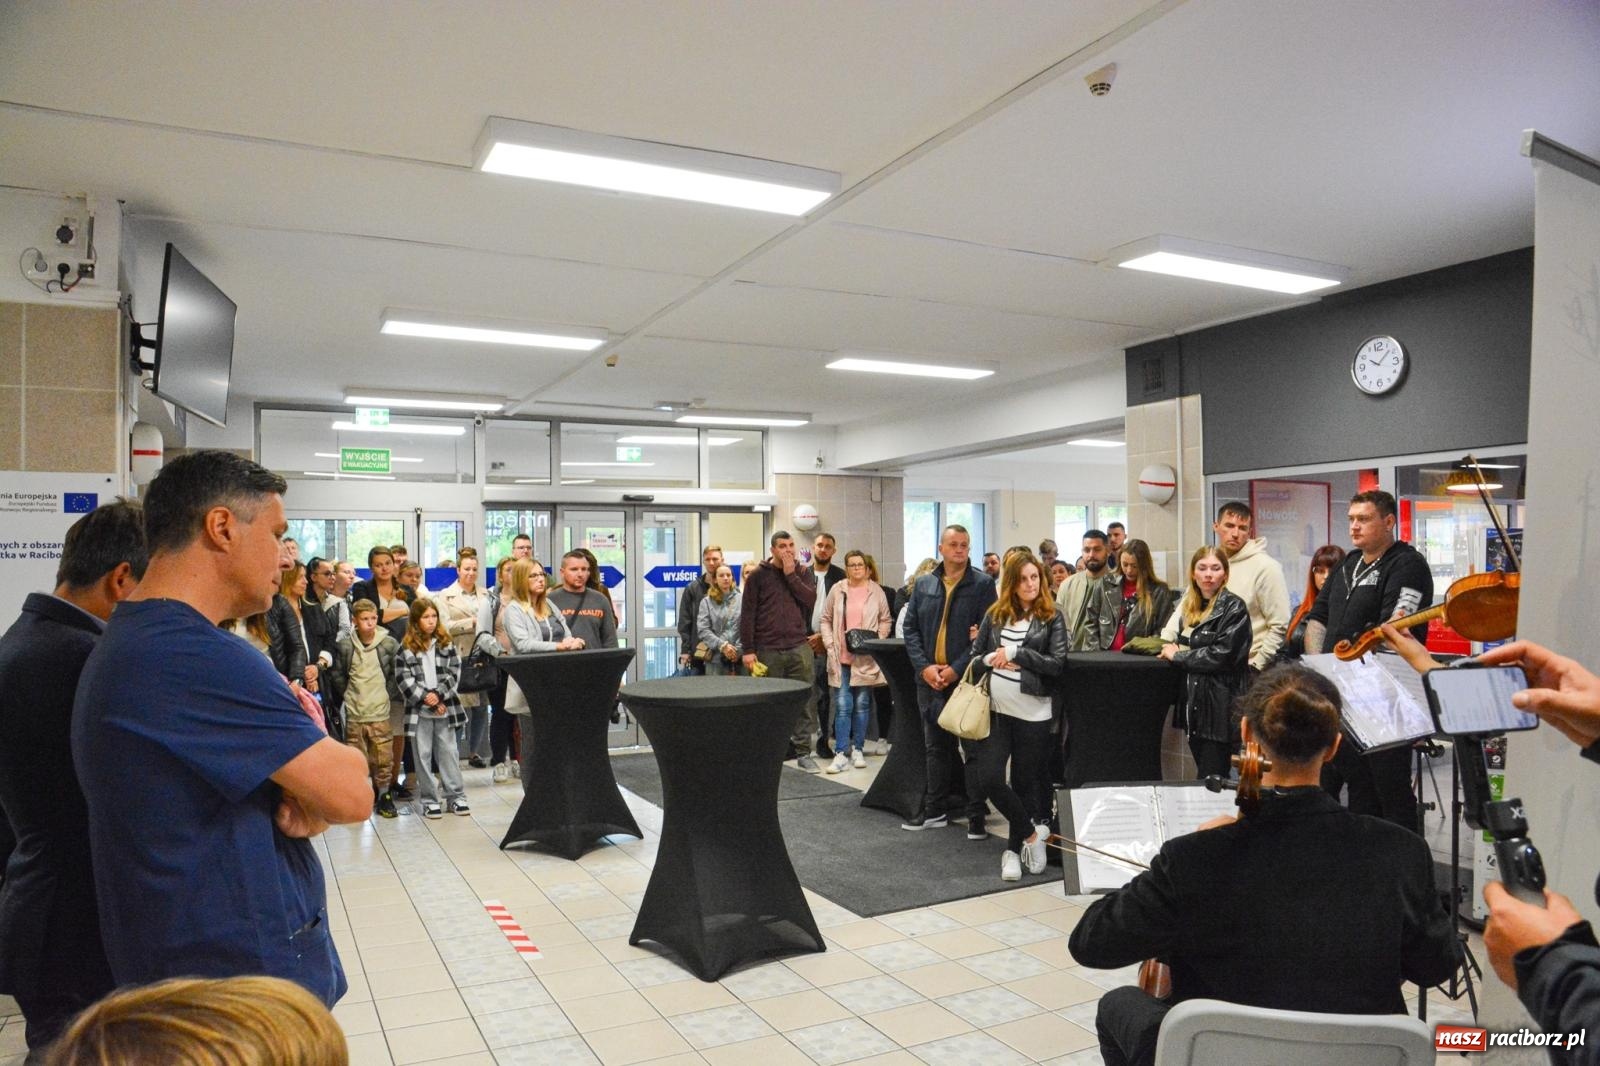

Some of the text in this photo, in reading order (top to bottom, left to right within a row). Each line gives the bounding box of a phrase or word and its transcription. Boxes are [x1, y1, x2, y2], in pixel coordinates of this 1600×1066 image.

[1374, 342, 1384, 352] 12
[1392, 356, 1400, 366] 3
[1359, 364, 1366, 372] 9
[1376, 378, 1384, 388] 6
[14, 492, 57, 501] Europejska
[663, 570, 698, 582] WYJŚCIE
